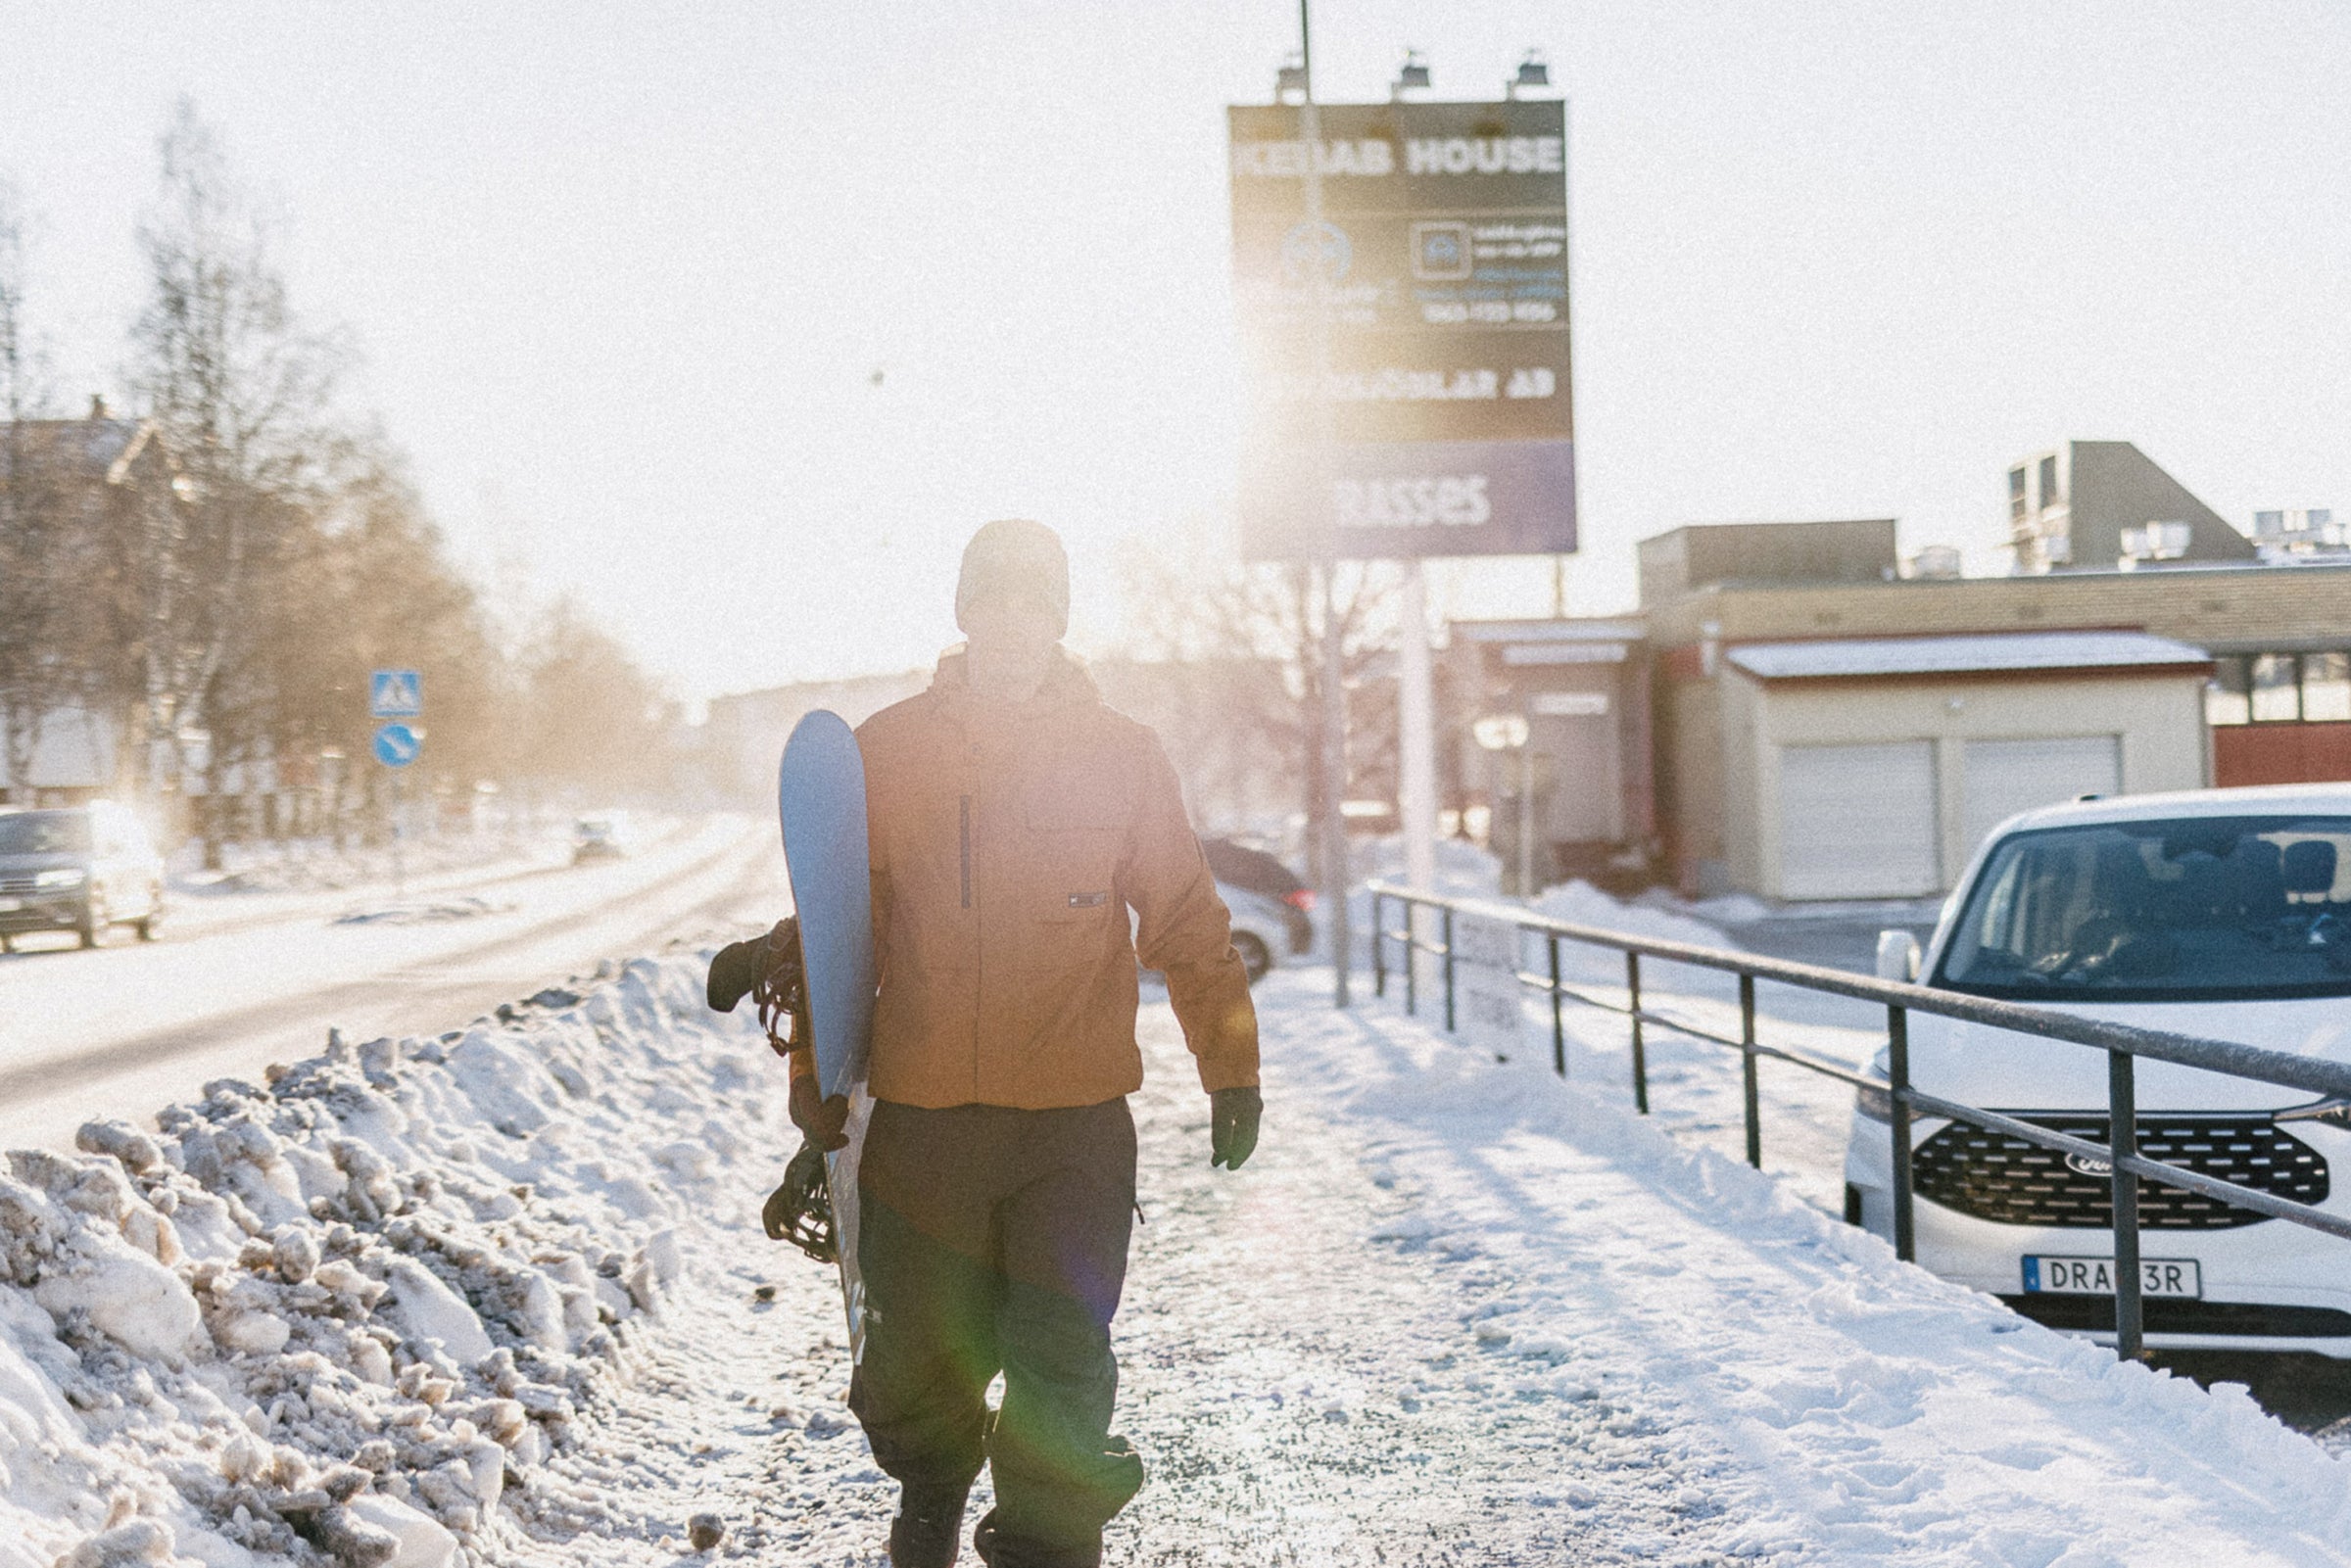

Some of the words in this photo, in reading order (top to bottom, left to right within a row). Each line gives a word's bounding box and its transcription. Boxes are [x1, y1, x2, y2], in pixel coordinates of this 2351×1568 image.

[1406, 136, 1562, 174] HOUSE
[2050, 1261, 2110, 1290] DRA
[2143, 1264, 2183, 1293] 3R
